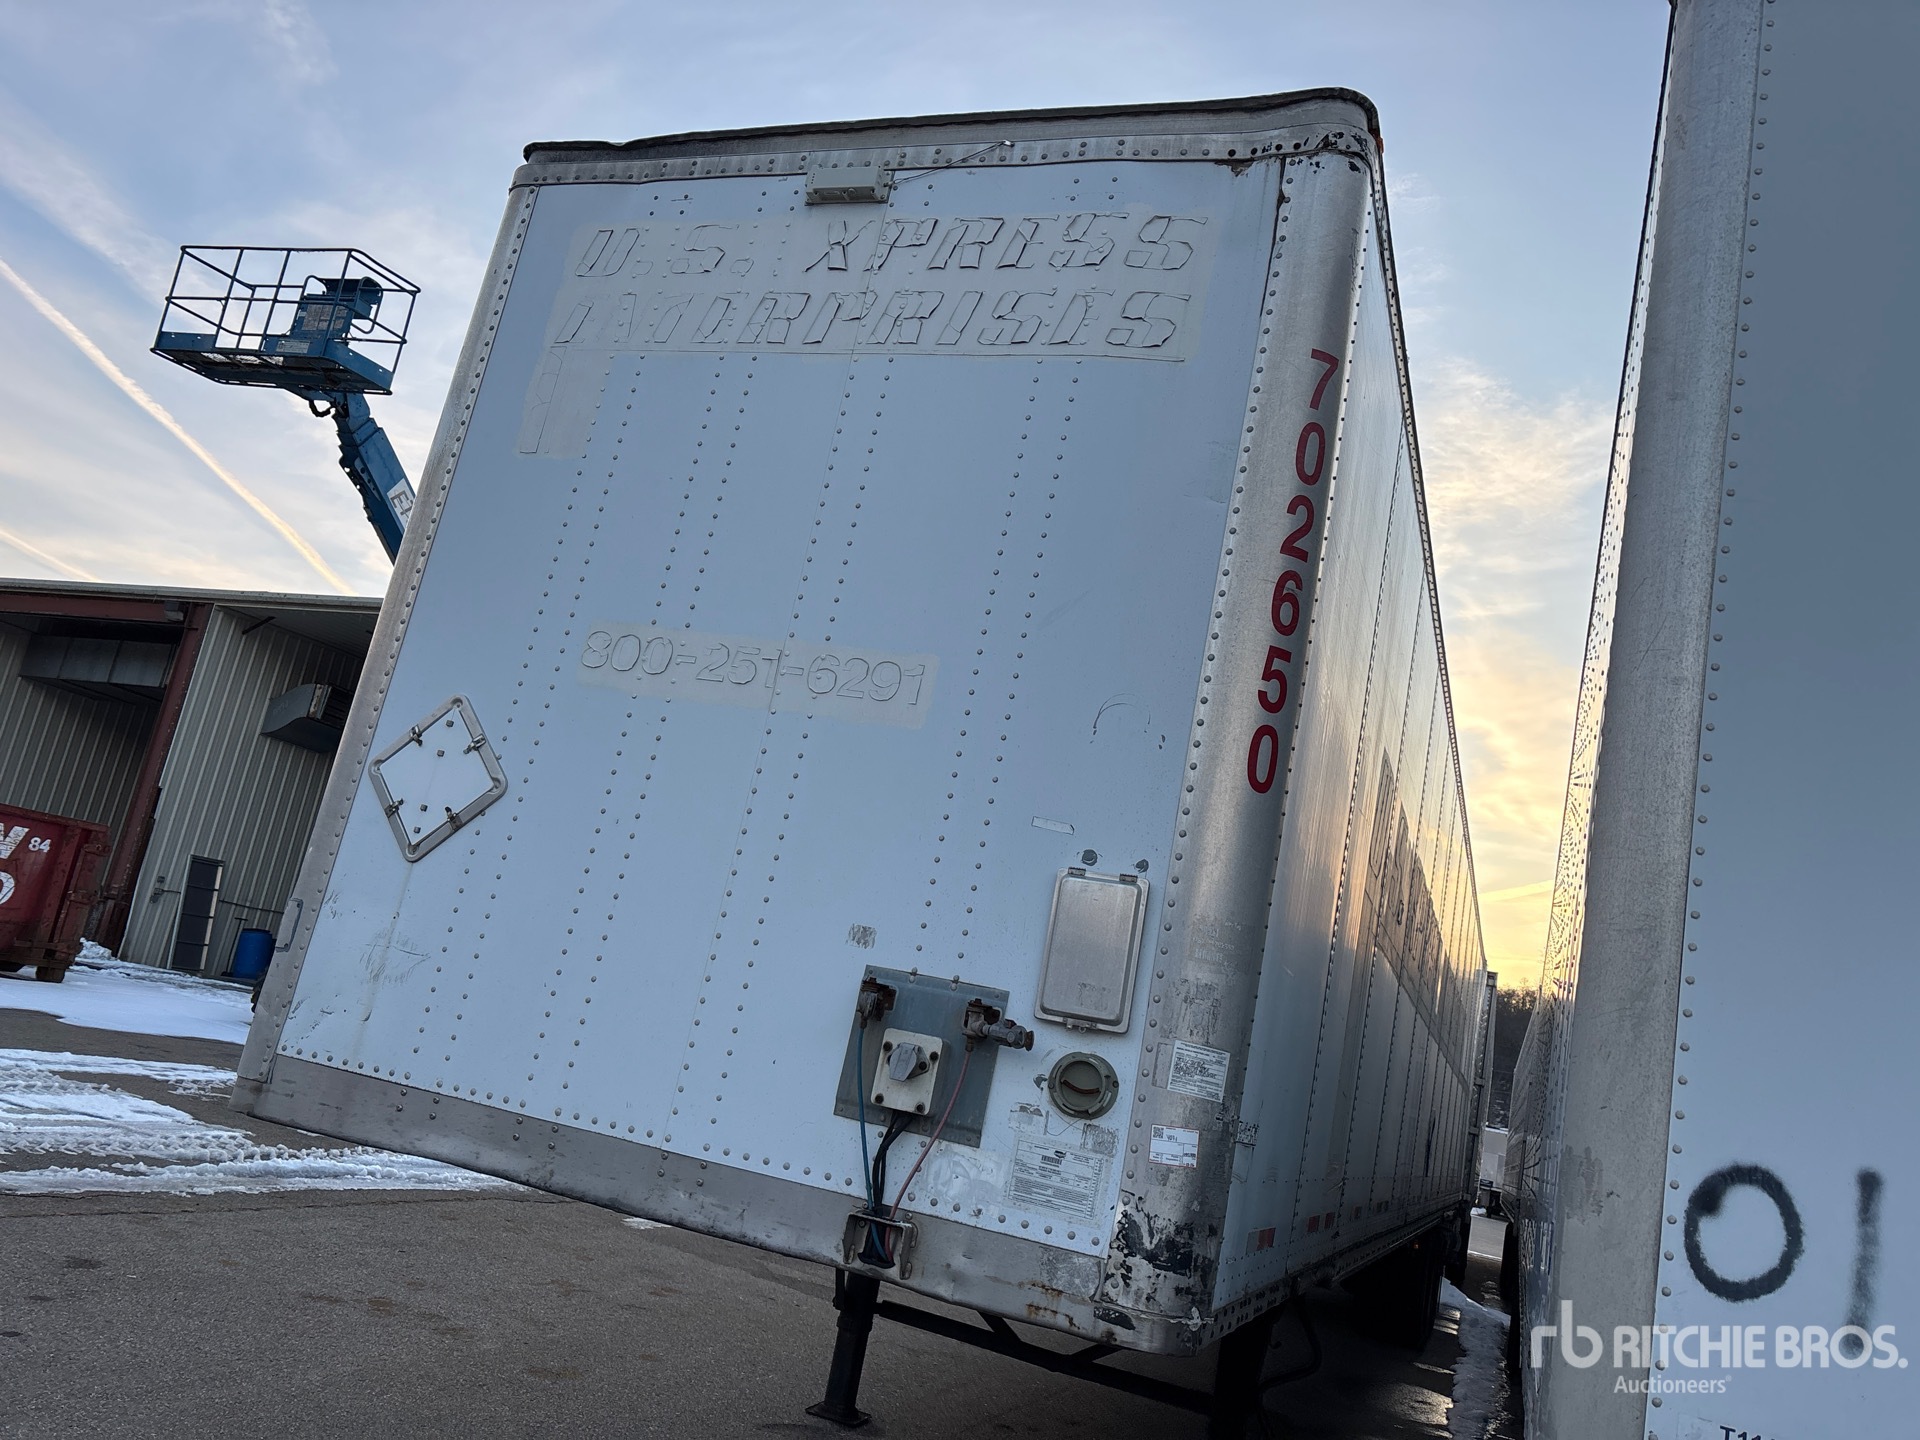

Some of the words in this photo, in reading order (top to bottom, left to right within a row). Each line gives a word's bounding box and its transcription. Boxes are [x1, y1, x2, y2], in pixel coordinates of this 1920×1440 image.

[803, 212, 1209, 274] XPRESS
[1246, 347, 1340, 795] 702650
[580, 630, 926, 706] 800-251-6291
[28, 836, 52, 853] 84
